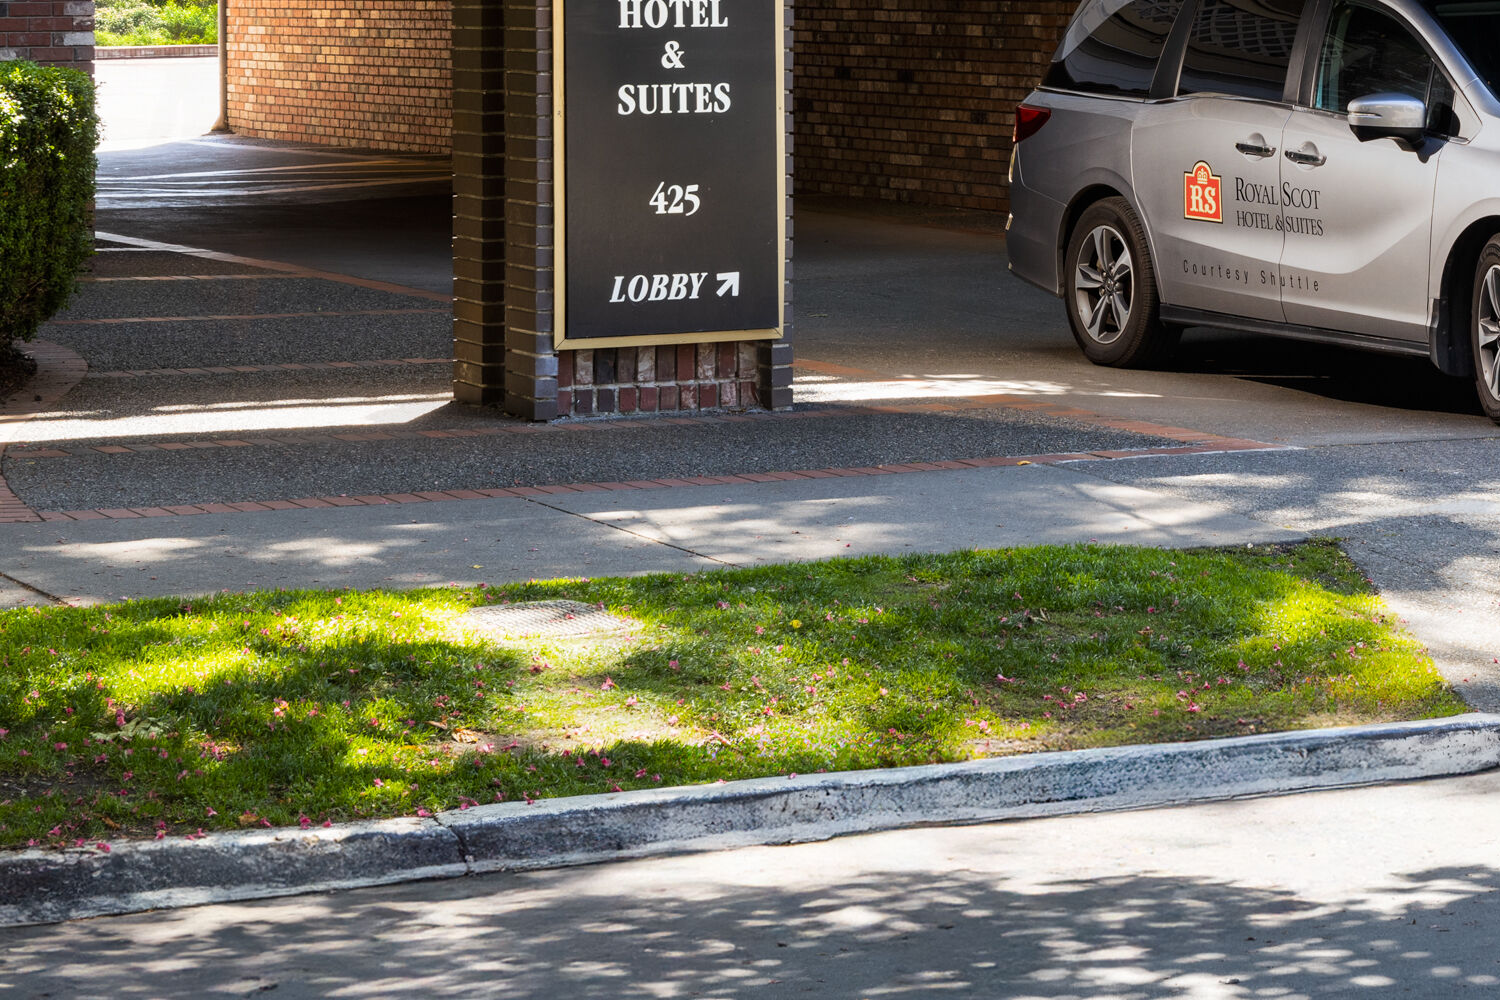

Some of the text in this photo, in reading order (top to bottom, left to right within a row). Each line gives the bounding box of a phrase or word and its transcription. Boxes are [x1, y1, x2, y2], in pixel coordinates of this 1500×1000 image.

[661, 41, 685, 69] &
[618, 83, 731, 115] SUITES
[649, 182, 700, 216] 425
[1190, 185, 1216, 214] RS
[1237, 211, 1323, 236] HOTEL & SUITES
[610, 273, 708, 302] LOBBY
[1184, 260, 1319, 291] Courtesy Shuttle
